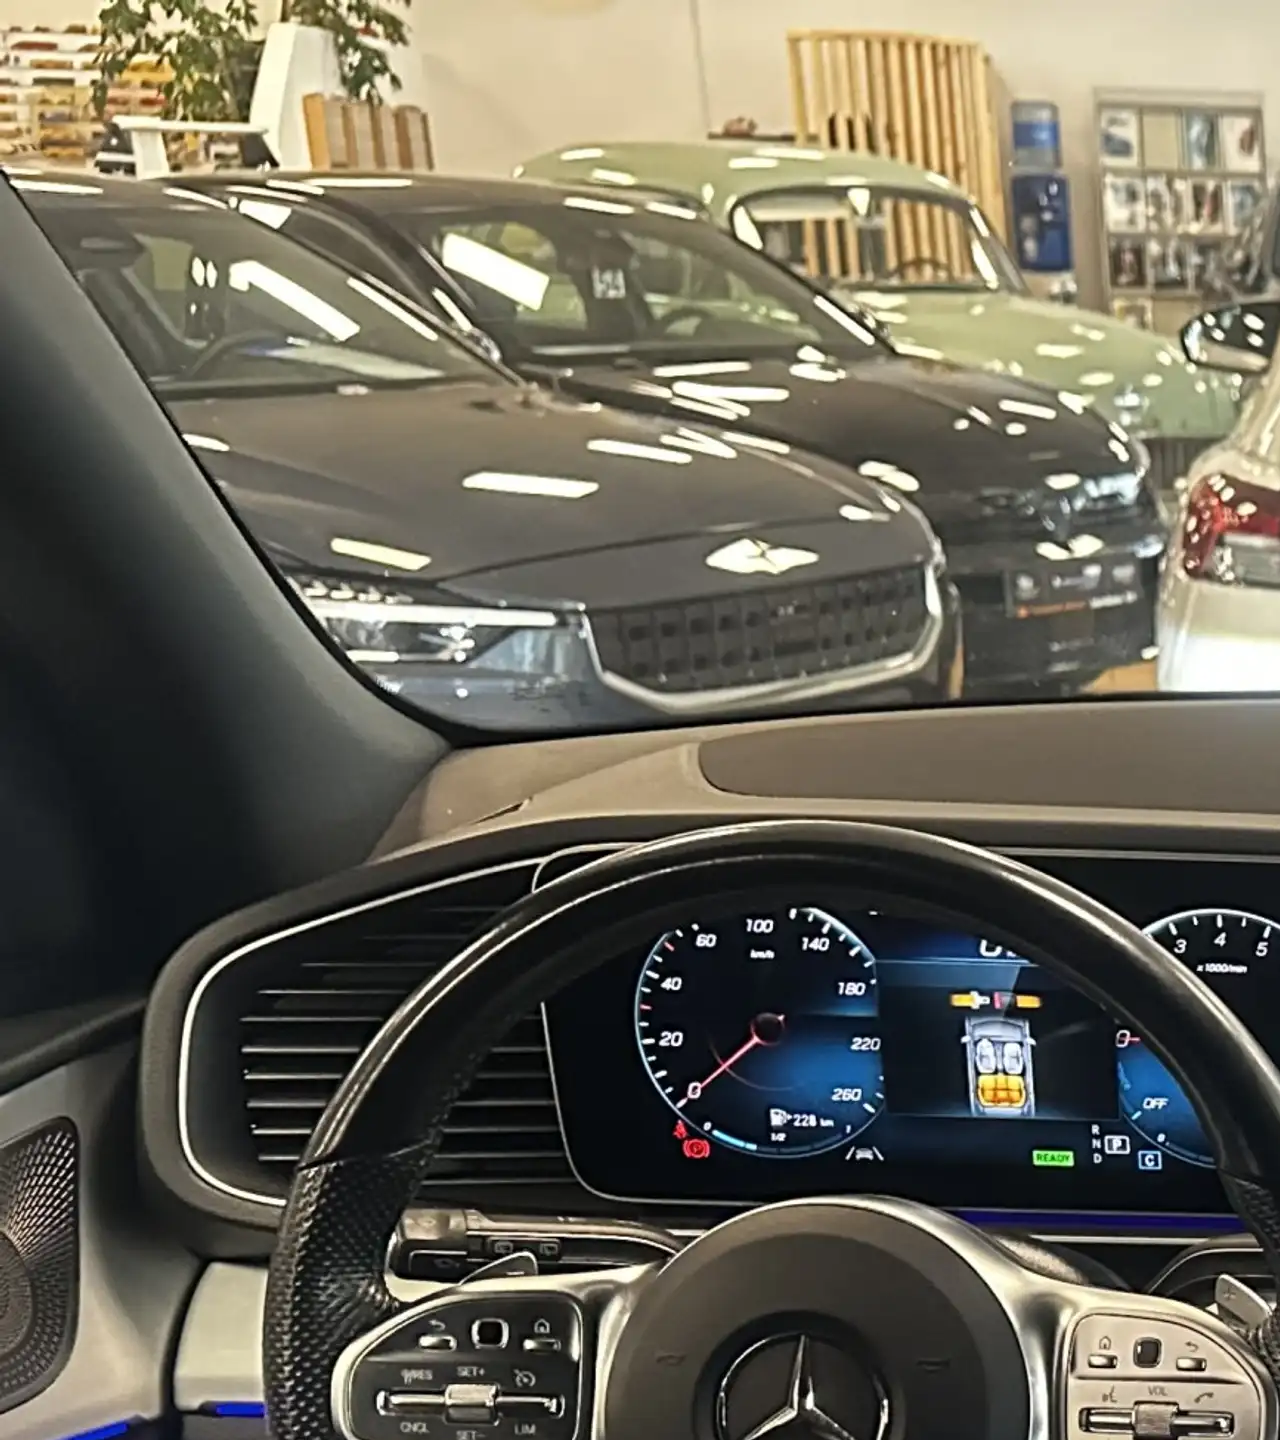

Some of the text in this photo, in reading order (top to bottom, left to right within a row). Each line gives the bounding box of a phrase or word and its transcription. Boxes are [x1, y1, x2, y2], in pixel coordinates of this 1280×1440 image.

[746, 918, 773, 933] 100
[695, 934, 716, 948] 60
[801, 937, 829, 952] 140
[1174, 939, 1187, 954] 3
[1213, 932, 1226, 947] 4
[1255, 942, 1268, 957] 5
[660, 977, 682, 991] 40
[838, 982, 866, 996] 180
[659, 1032, 683, 1047] 20
[851, 1037, 881, 1051] 220
[687, 1082, 702, 1099] 0
[831, 1088, 862, 1102] 260
[1143, 1097, 1169, 1109] OFF
[1091, 1125, 1100, 1135] R
[1111, 1138, 1122, 1150] P
[1036, 1153, 1071, 1164] READY
[1145, 1154, 1155, 1167] C
[1147, 1386, 1168, 1397] VOL
[514, 1423, 536, 1435] LIM
